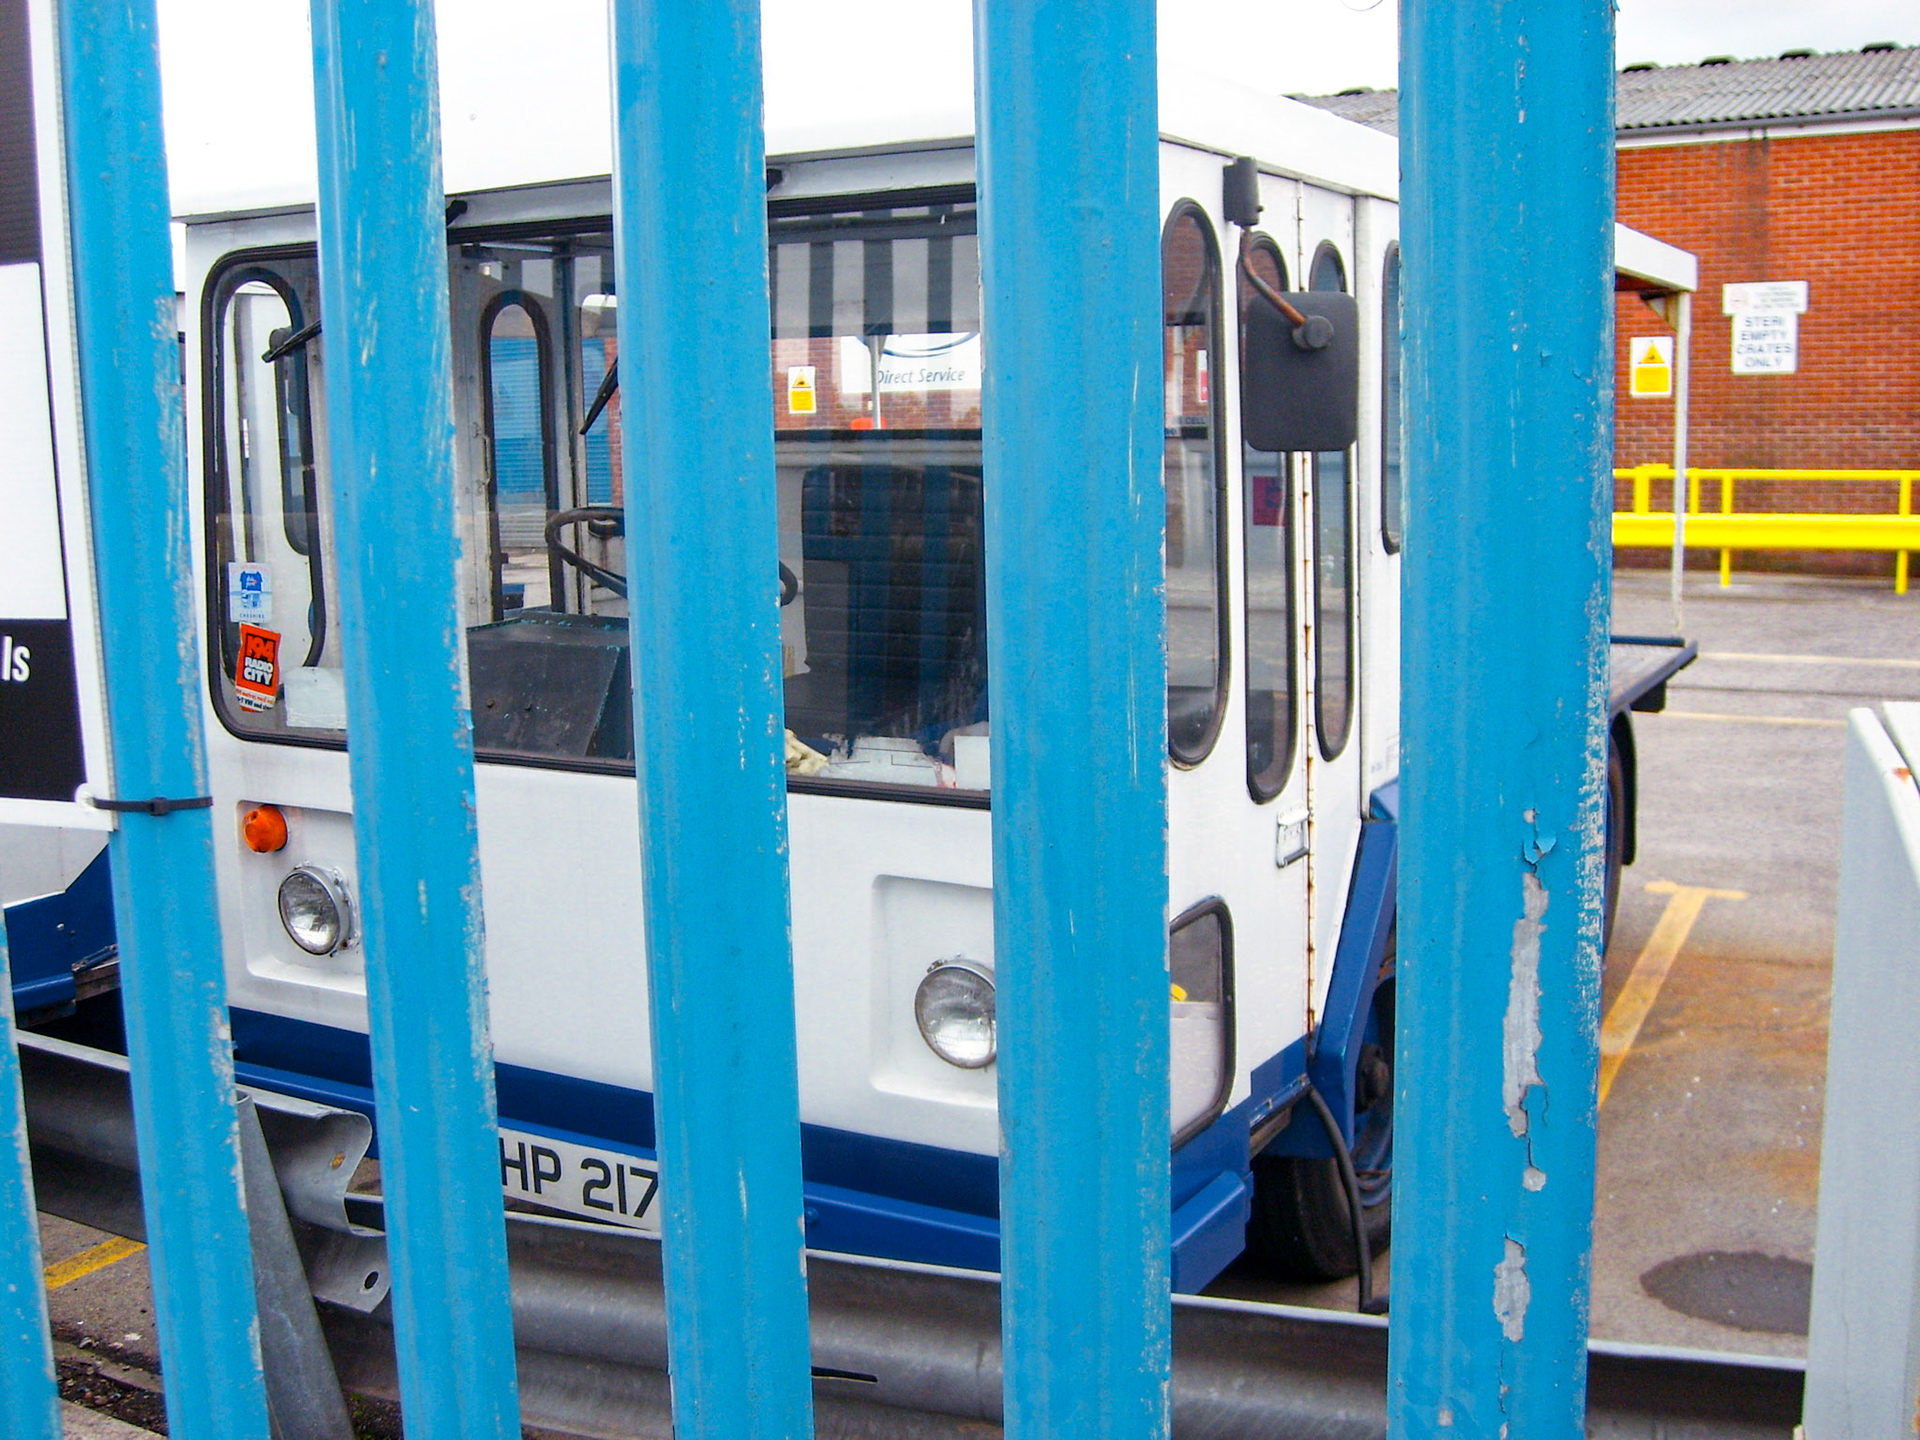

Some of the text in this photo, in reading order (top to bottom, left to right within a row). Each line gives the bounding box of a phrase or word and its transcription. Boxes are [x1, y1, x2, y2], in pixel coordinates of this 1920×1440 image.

[1741, 329, 1788, 341] EMPTY
[1736, 343, 1793, 355] CRATES
[1745, 356, 1783, 368] ONLY
[878, 367, 966, 384] Direct Service
[245, 656, 273, 673] RADIO
[243, 666, 273, 686] CITY
[498, 1137, 659, 1219] HP 217
